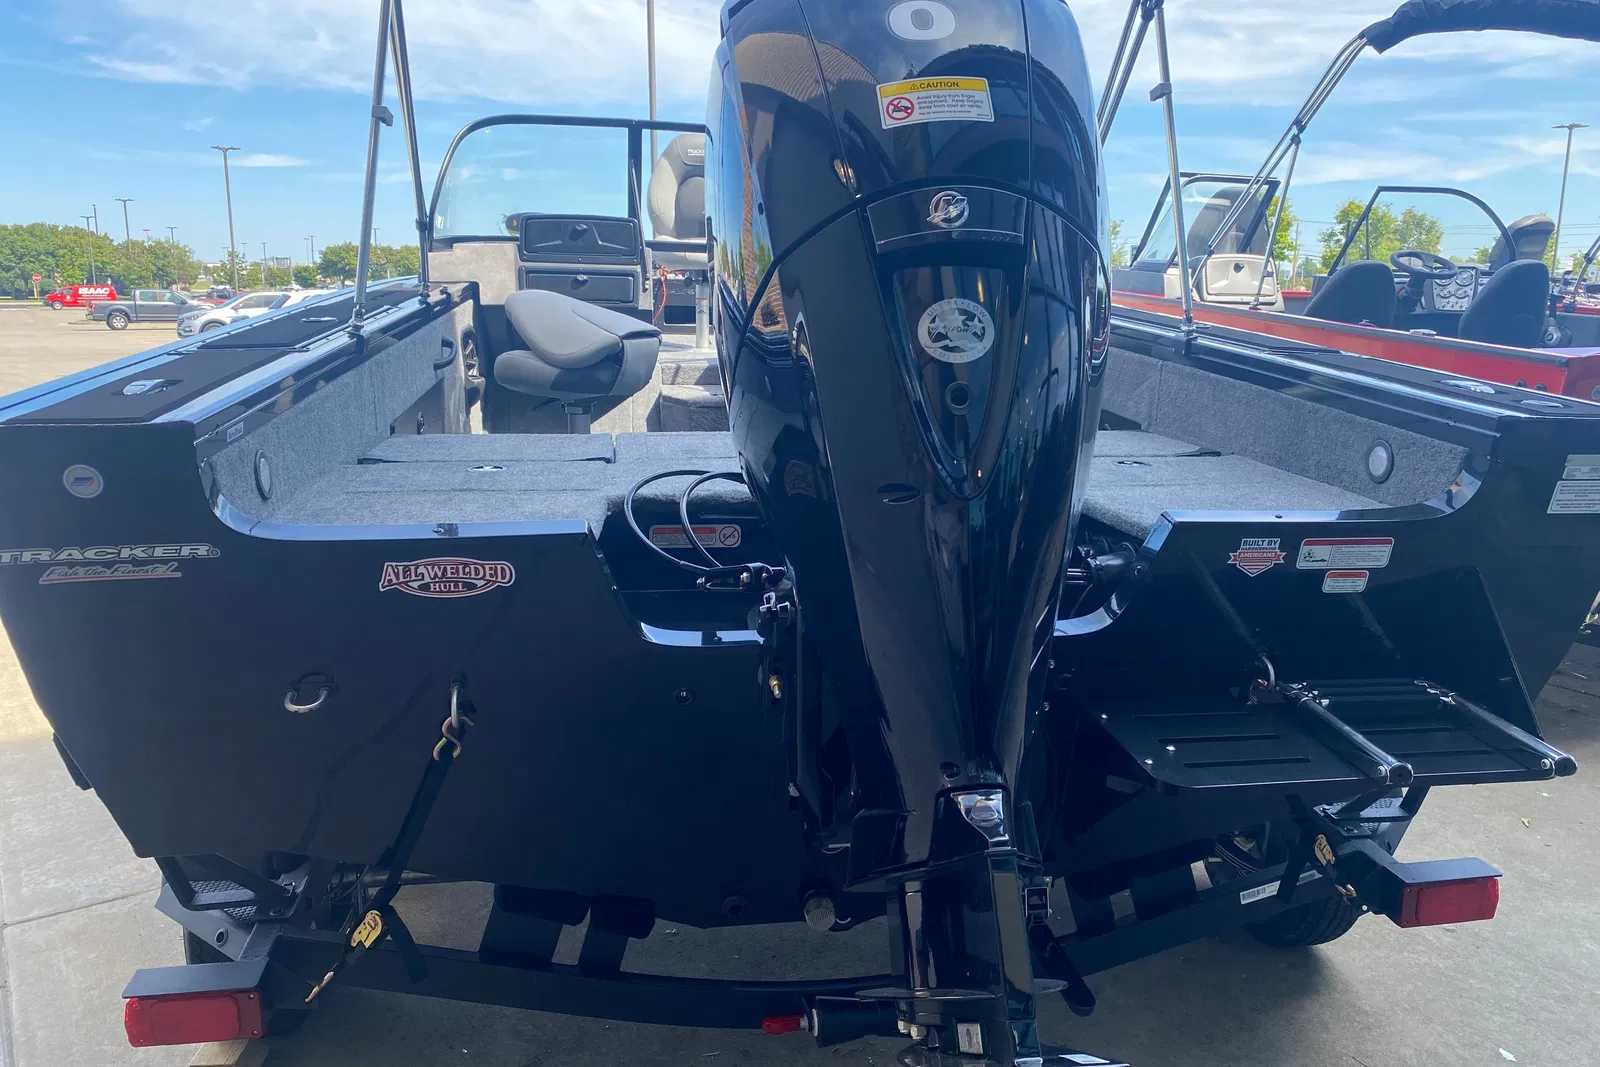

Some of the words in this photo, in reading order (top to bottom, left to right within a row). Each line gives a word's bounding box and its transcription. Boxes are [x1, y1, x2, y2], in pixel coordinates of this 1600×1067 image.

[919, 81, 960, 90] CAUTION
[966, 302, 987, 318] LOW
[45, 566, 80, 578] Fish
[84, 566, 107, 577] the
[382, 564, 423, 586] ALL
[425, 564, 511, 581] WELDED
[429, 582, 467, 591] HULL
